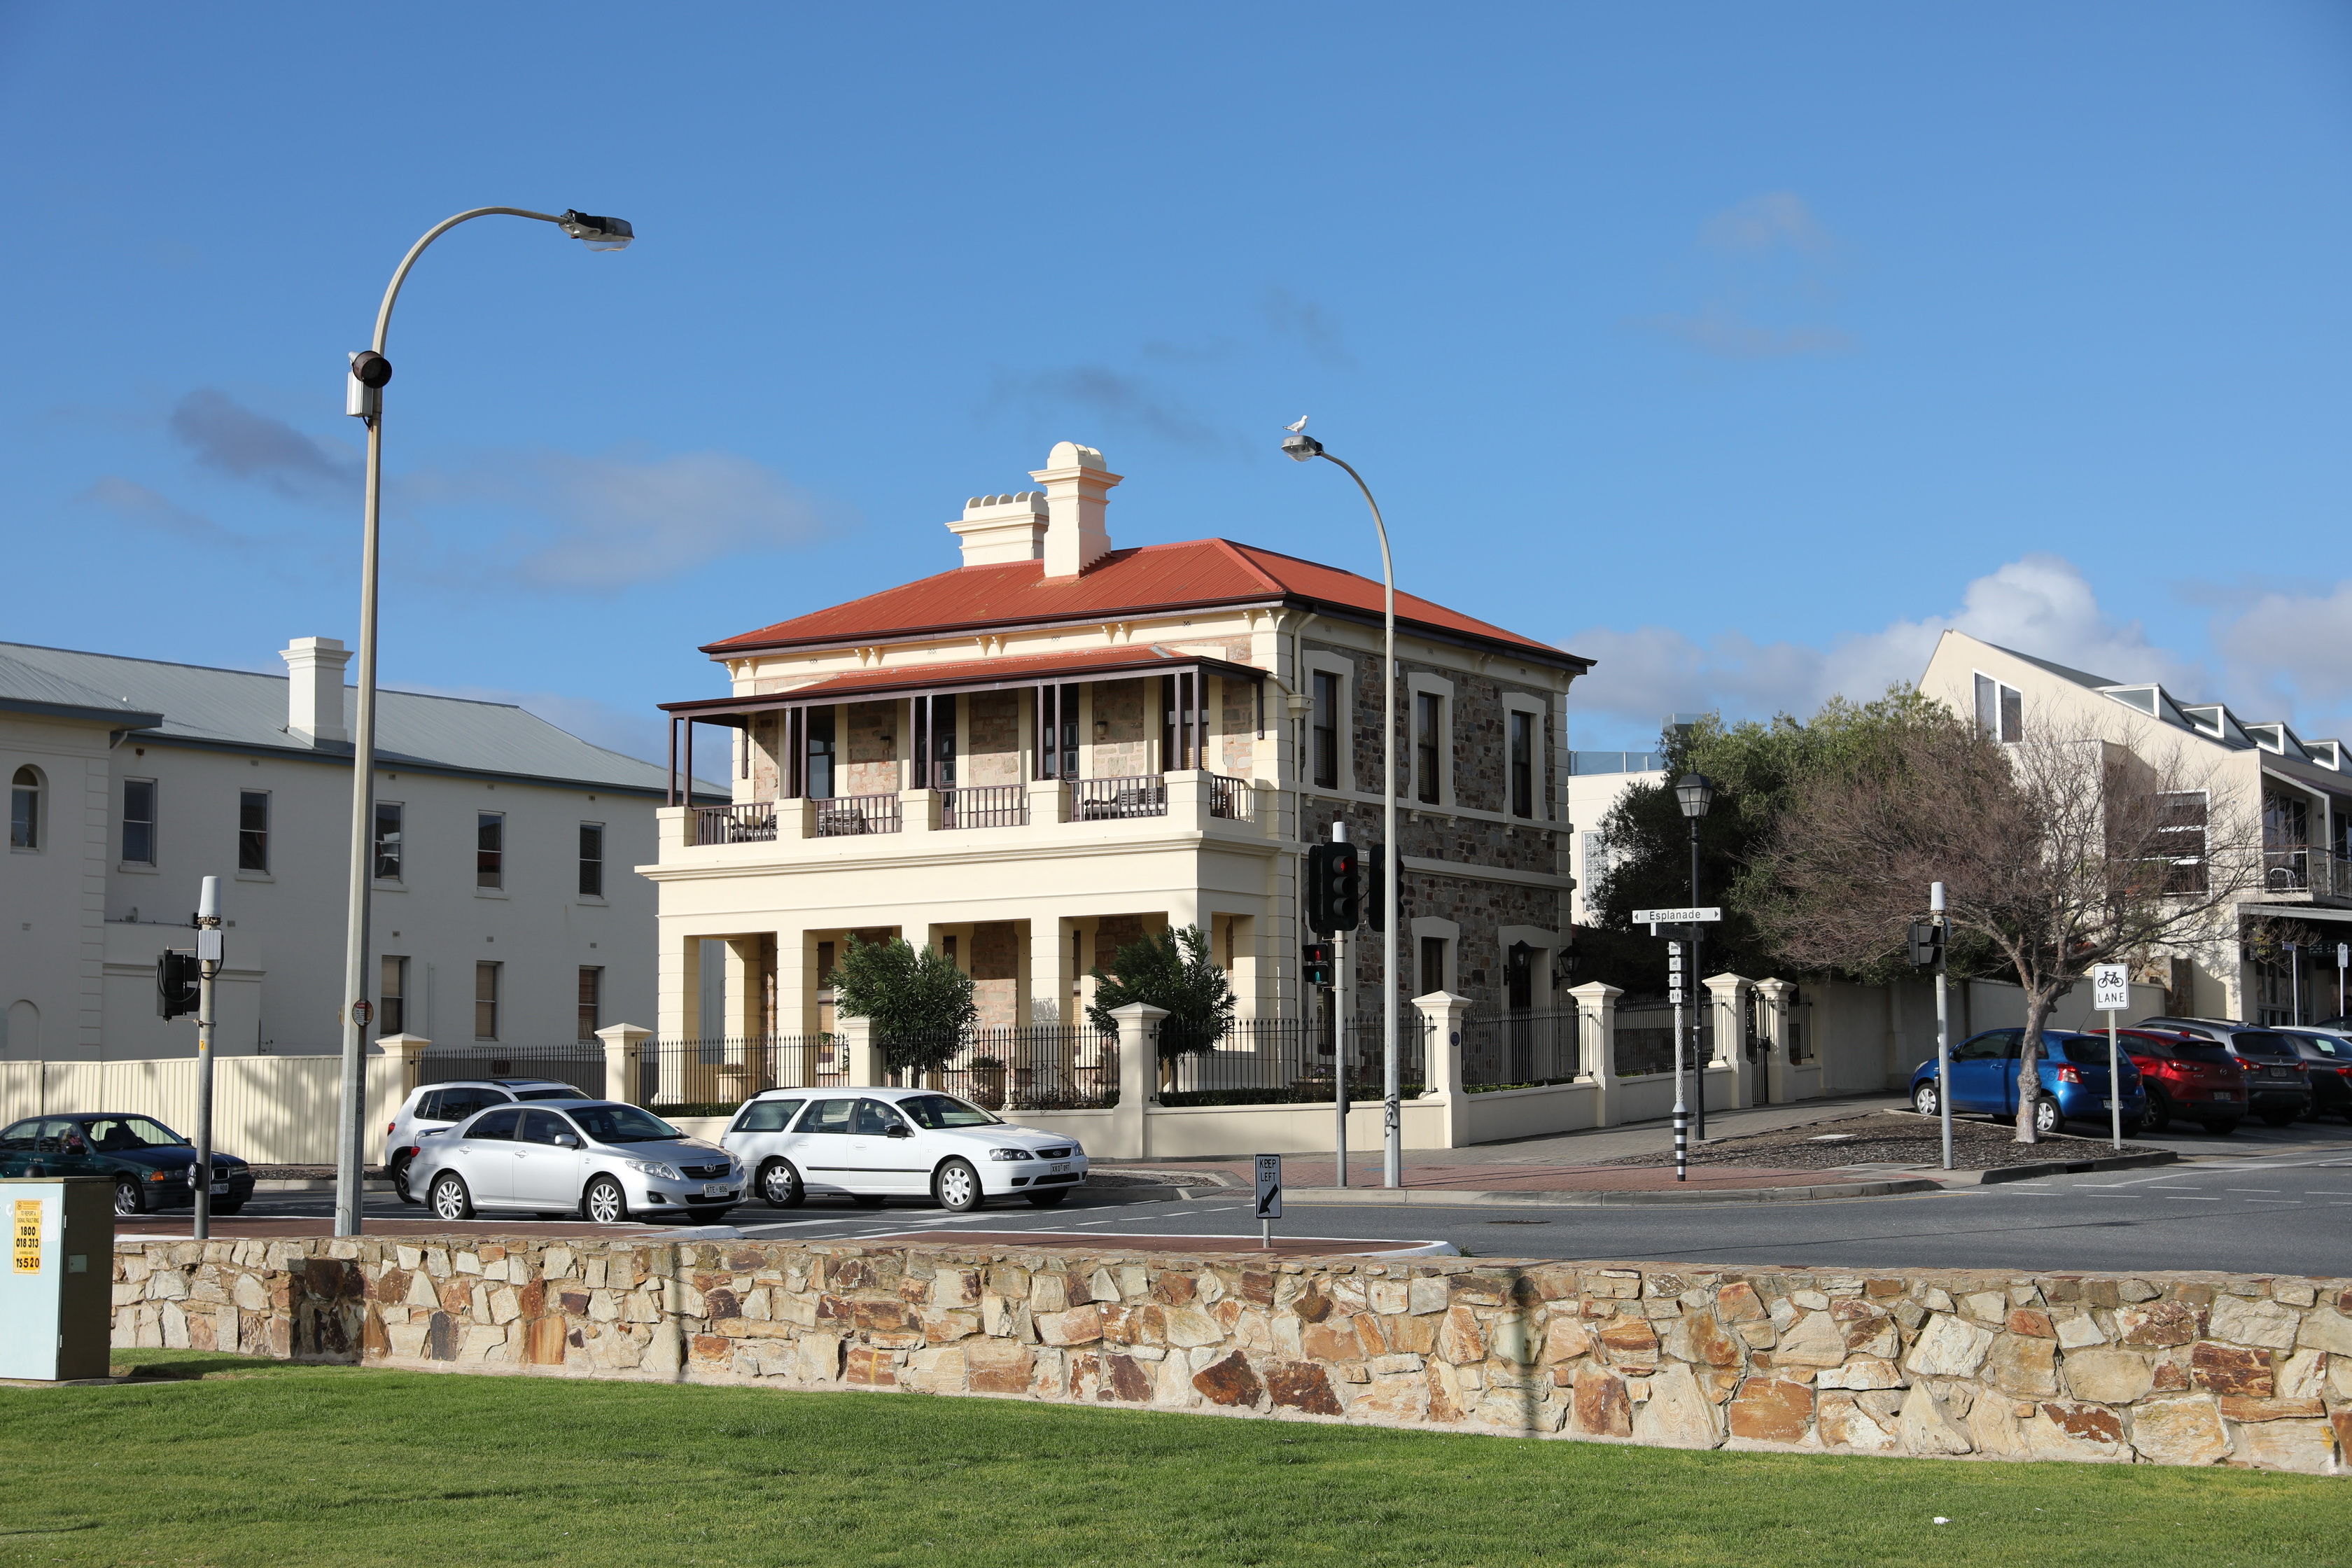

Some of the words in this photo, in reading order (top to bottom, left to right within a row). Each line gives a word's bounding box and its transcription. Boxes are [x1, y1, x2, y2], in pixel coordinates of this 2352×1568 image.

[1649, 910, 1700, 922] Esplanade
[2098, 992, 2124, 1002] LANE
[1259, 1158, 1276, 1168] KEEP
[1261, 1172, 1276, 1182] LEFT
[21, 1226, 36, 1236] 1800
[16, 1238, 27, 1247] 018
[28, 1238, 38, 1248] 313
